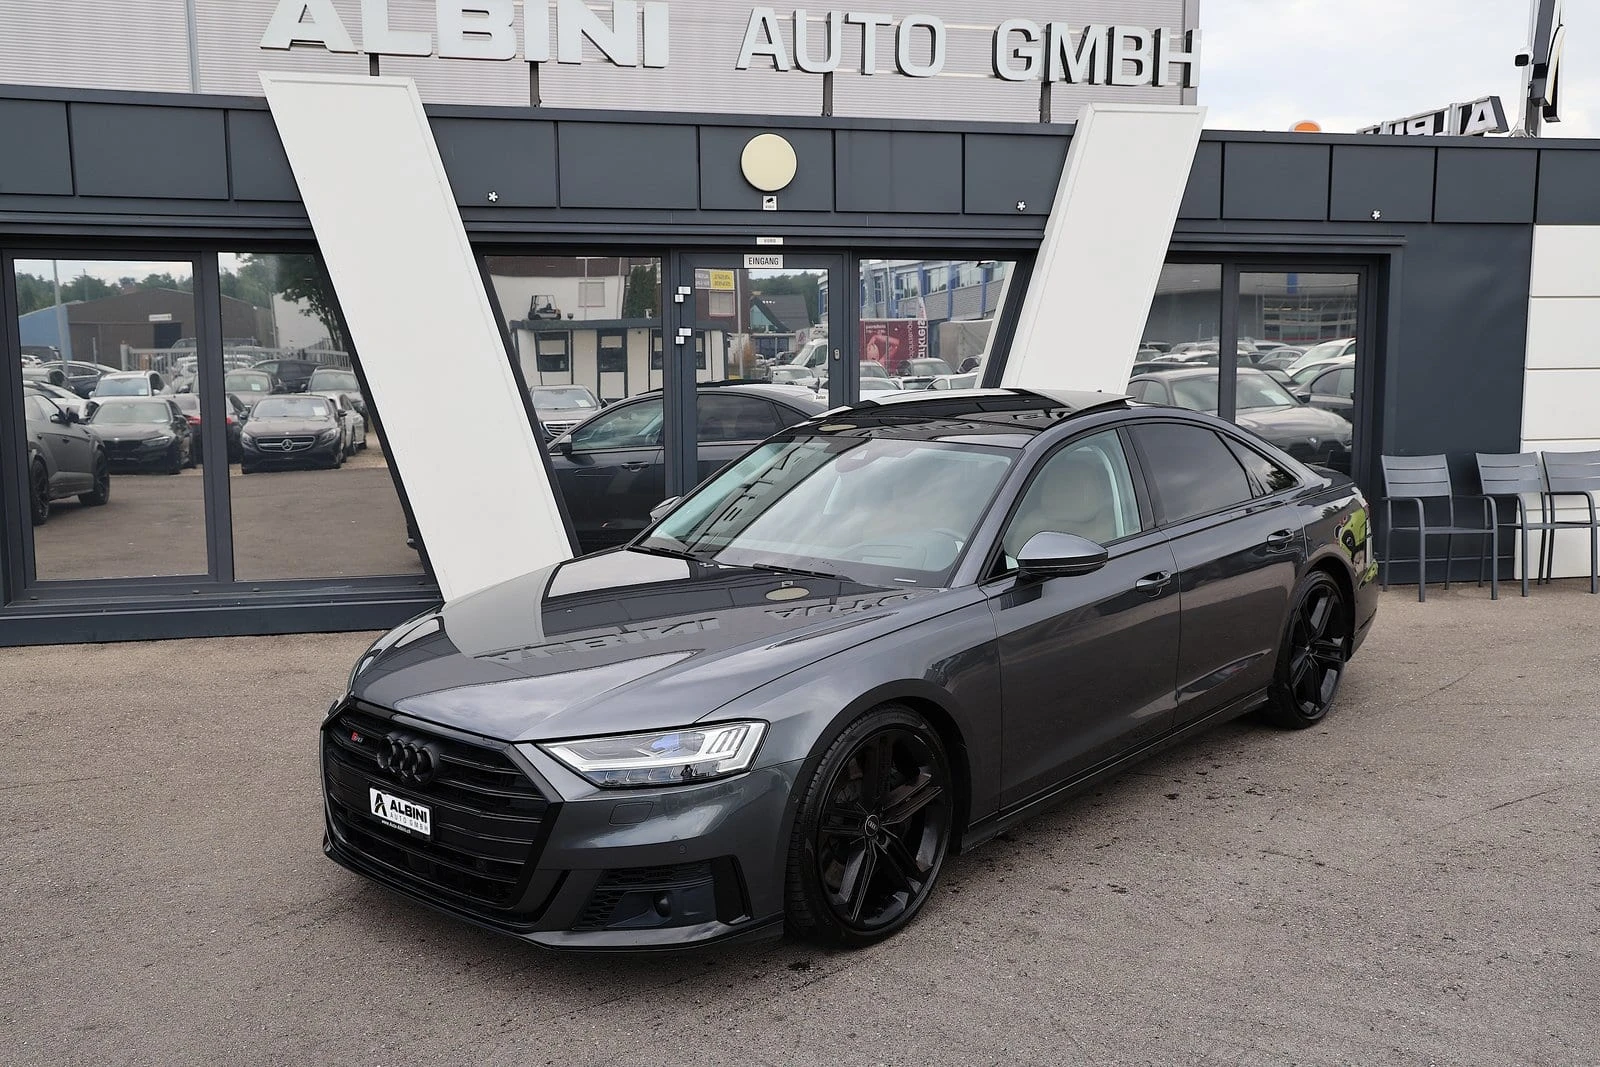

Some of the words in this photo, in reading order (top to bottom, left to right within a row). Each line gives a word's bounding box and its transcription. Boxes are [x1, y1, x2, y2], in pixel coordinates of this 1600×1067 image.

[259, 0, 670, 69] ALBINI
[735, 6, 947, 78] AUTO
[991, 18, 1203, 88] GMBH
[748, 256, 780, 266] EINGANG
[390, 799, 428, 824] ALBINI
[390, 811, 408, 824] AUTO
